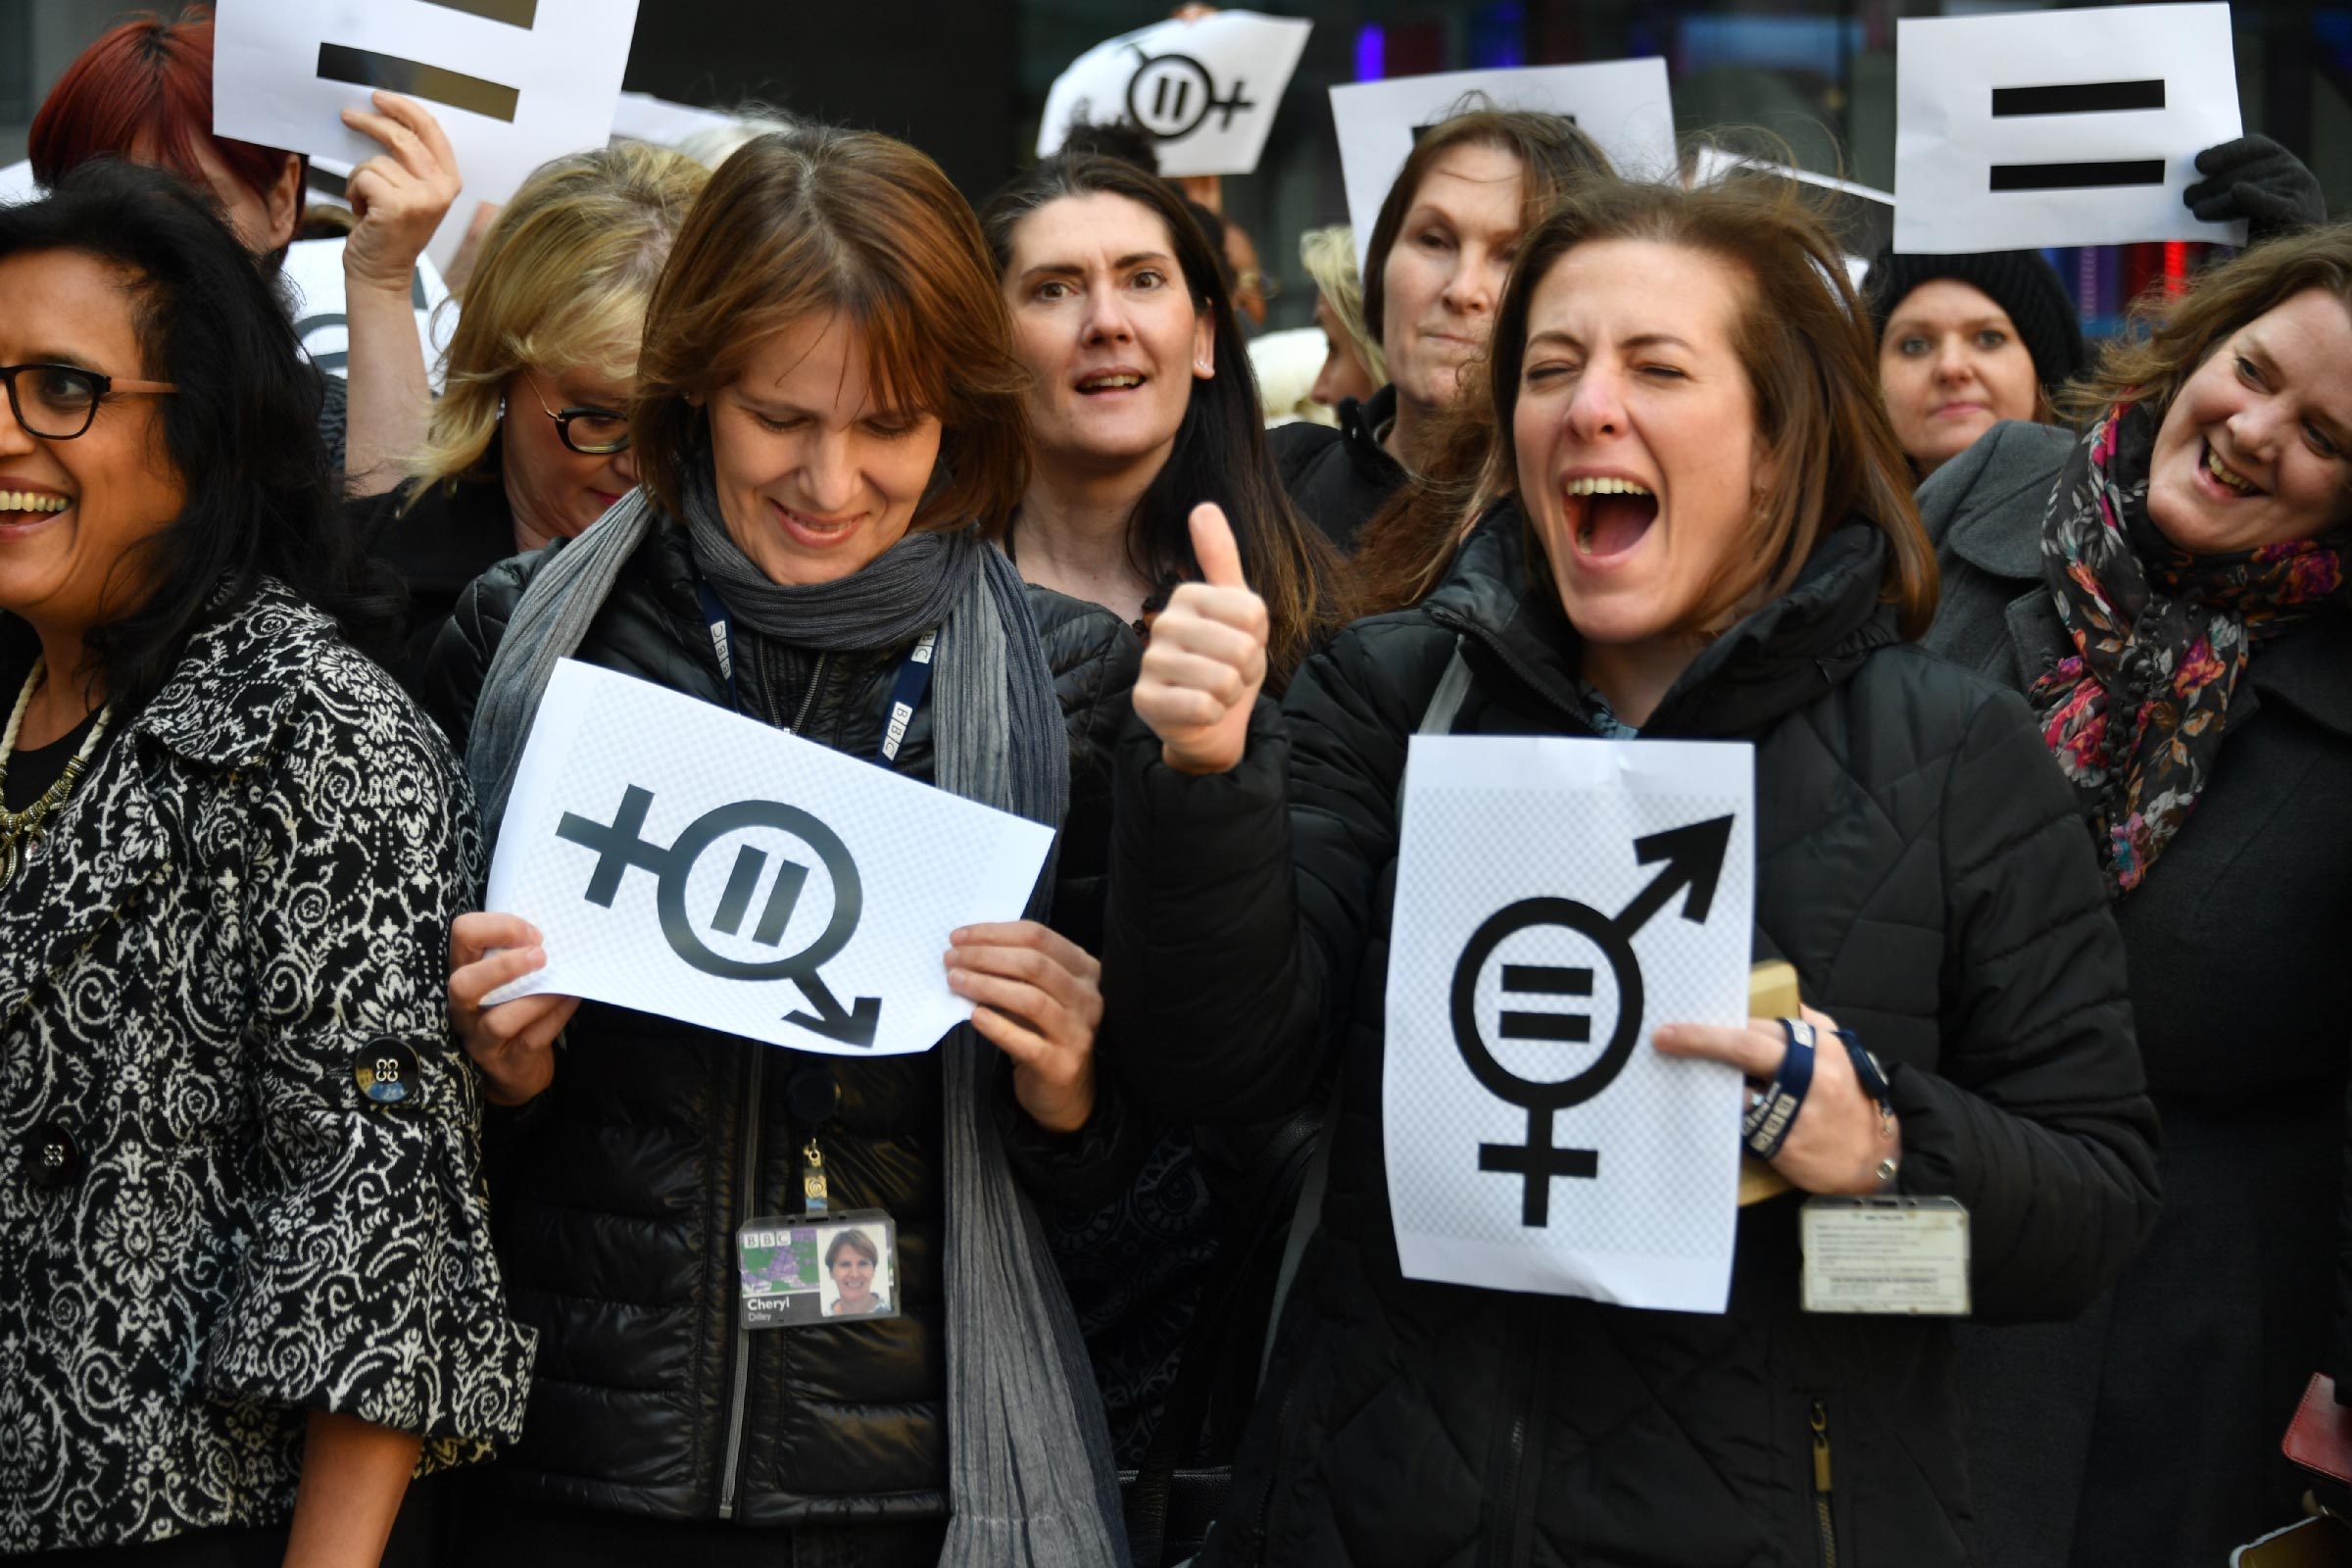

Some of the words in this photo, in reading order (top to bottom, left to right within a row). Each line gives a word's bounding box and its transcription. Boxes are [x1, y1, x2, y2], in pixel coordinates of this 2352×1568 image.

[884, 704, 910, 759] BBC
[746, 1232, 790, 1248] BBC
[747, 1296, 790, 1312] Cheryl
[748, 1312, 772, 1322] Dilley
